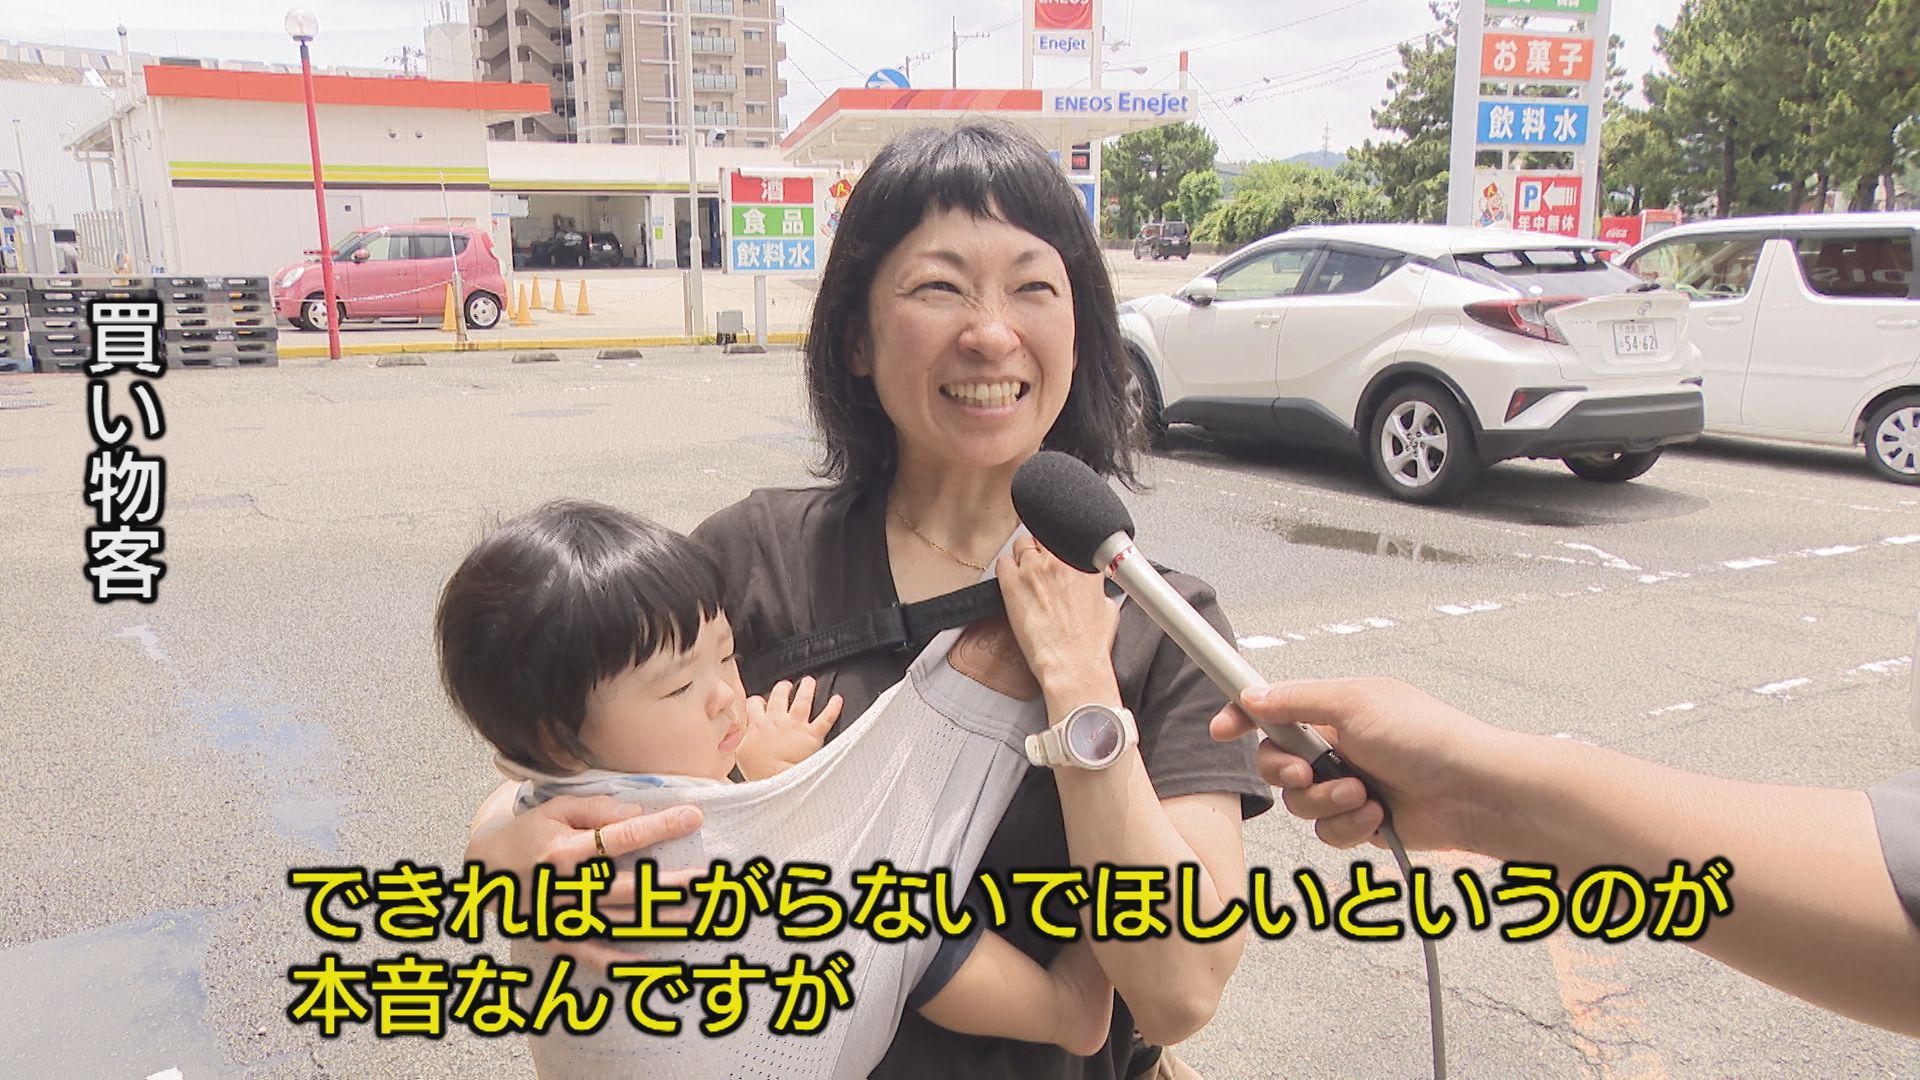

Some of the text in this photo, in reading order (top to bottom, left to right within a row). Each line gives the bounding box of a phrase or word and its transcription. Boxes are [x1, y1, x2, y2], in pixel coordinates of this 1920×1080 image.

[1492, 39, 1584, 76] お菓子
[1054, 96, 1113, 112] ENEOS
[1488, 105, 1579, 142] 飲料水
[1523, 184, 1539, 210] P
[742, 207, 805, 235] 食品
[1517, 214, 1575, 233] 年中無休
[736, 240, 811, 269] 飲料水
